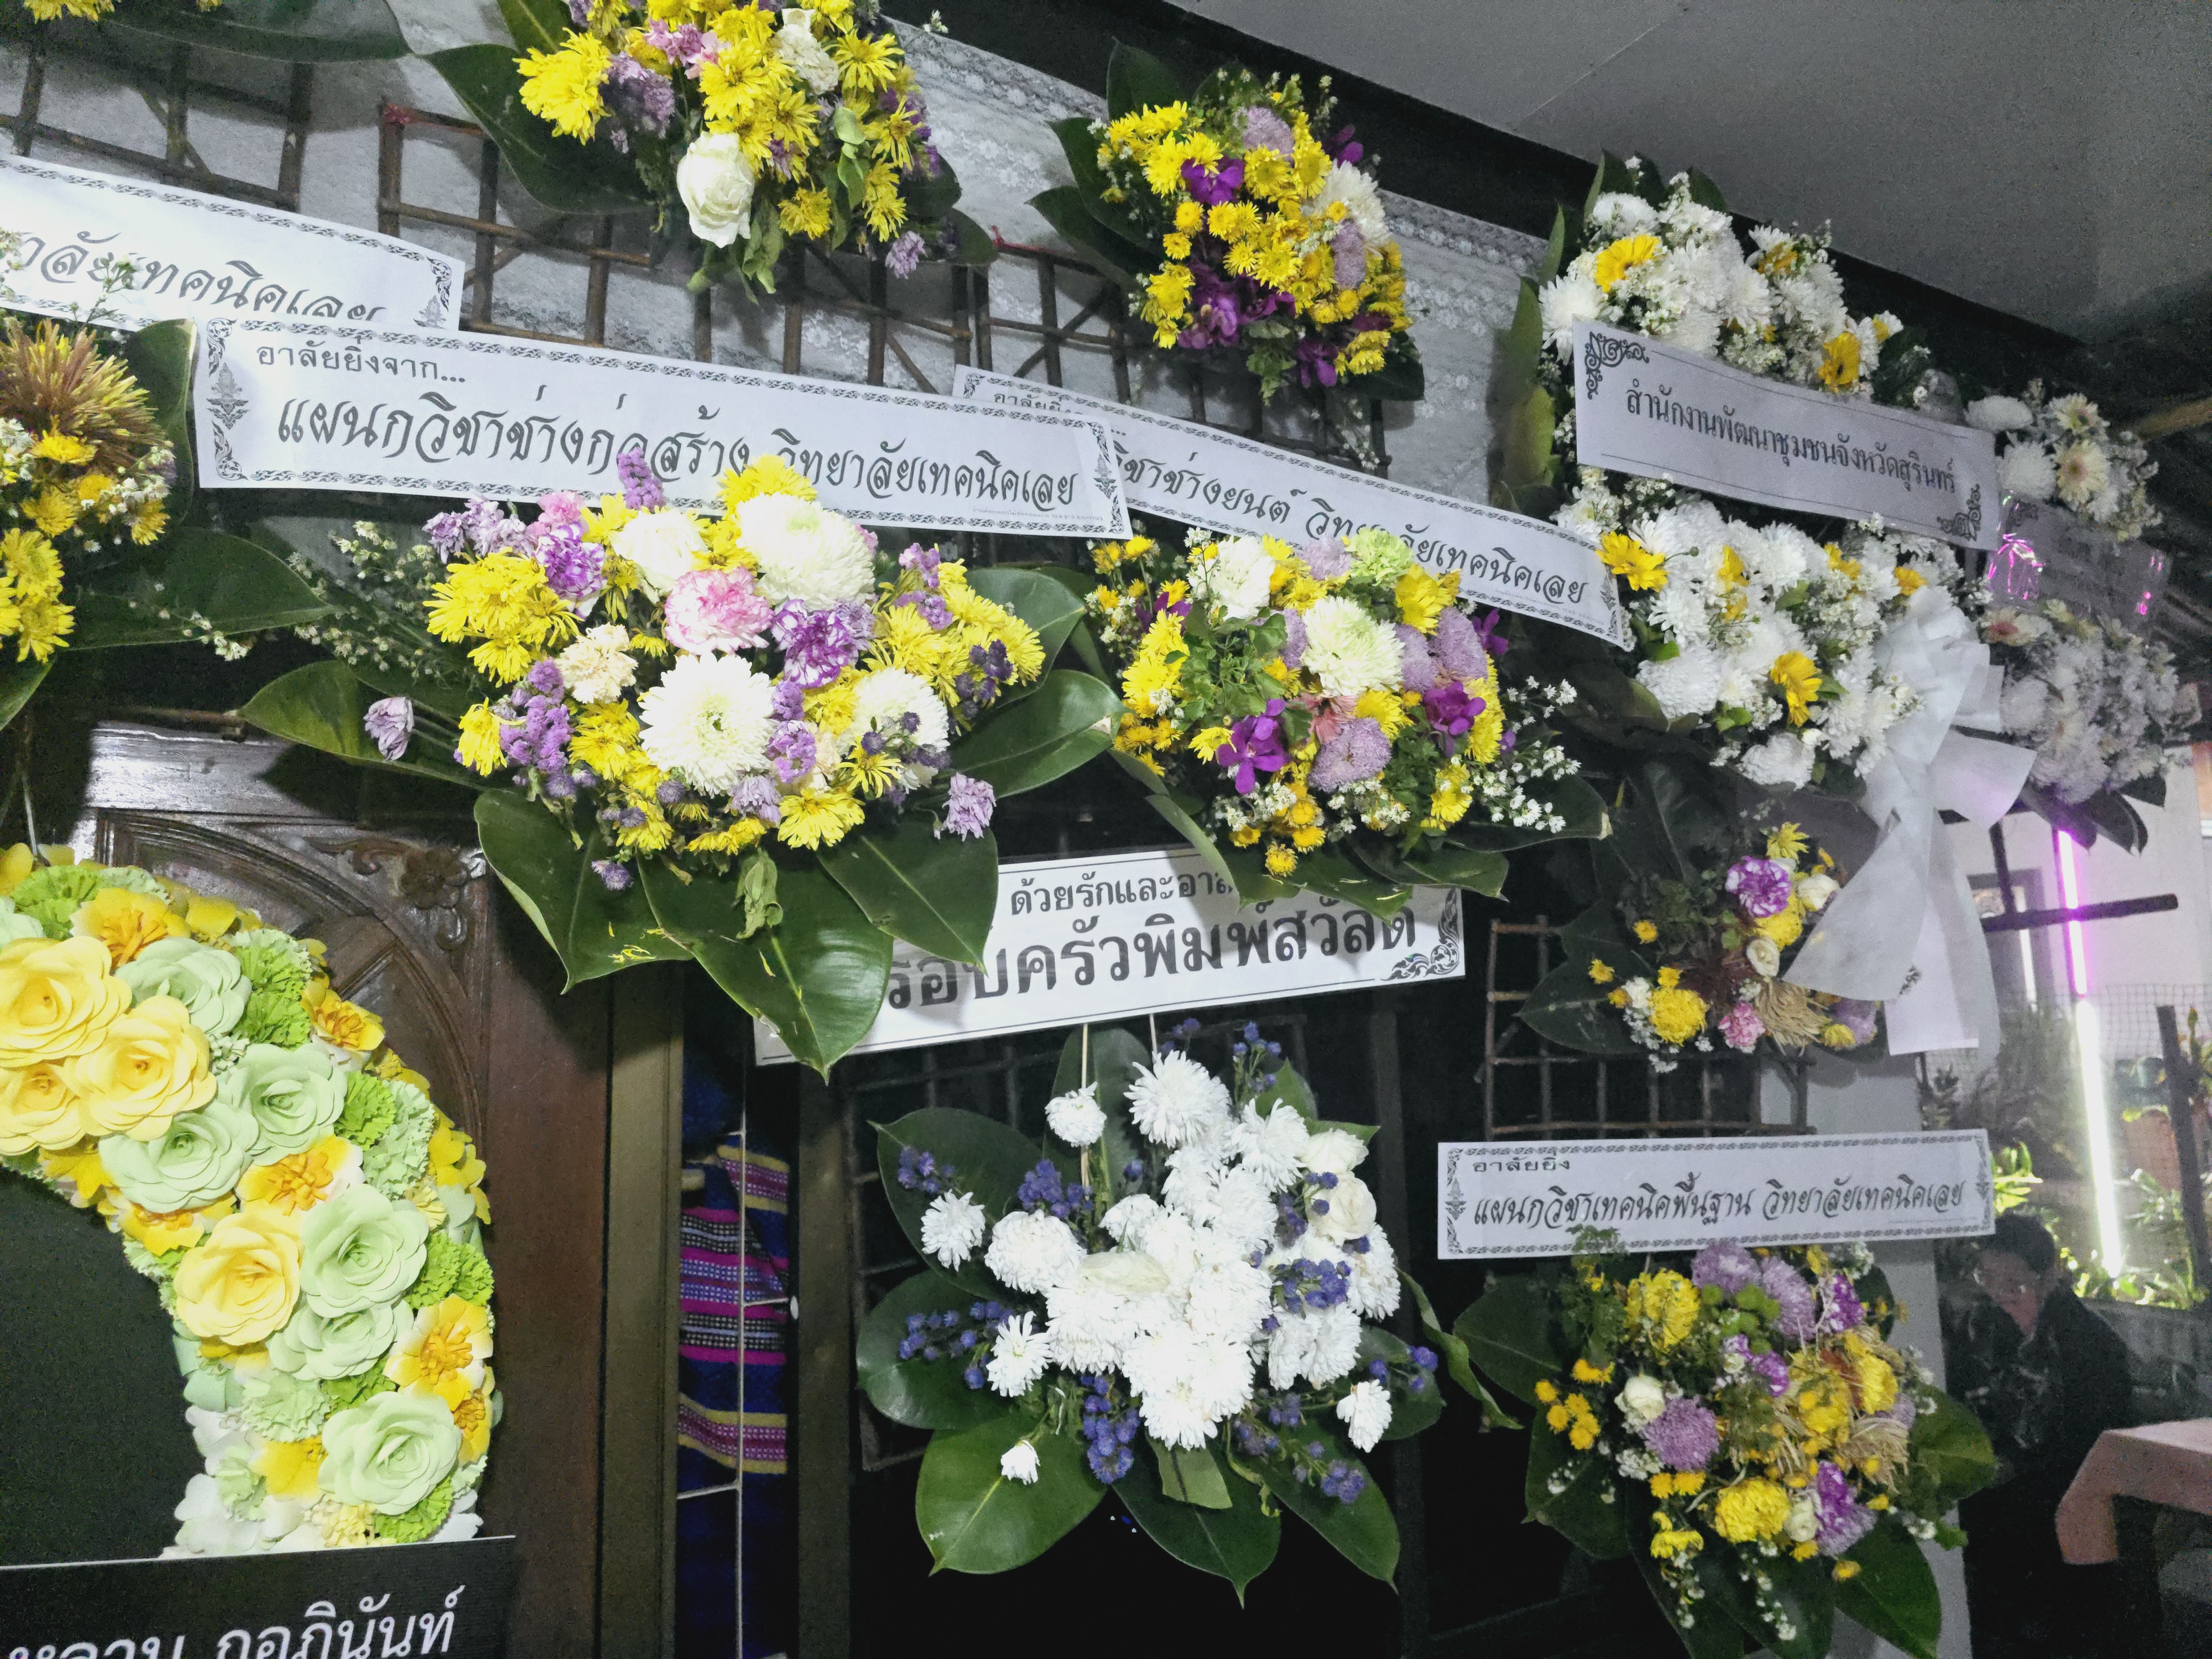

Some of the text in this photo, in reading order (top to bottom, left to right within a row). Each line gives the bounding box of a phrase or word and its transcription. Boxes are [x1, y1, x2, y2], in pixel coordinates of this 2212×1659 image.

[1626, 379, 1956, 493] สำนักงานพัฒนาชุมชนจังหวัดสุรินทร์
[1113, 441, 1588, 603] ิชาช่างยนต์ วิทัยเทคนิคเลย
[1473, 1150, 1570, 1172] อาลัยยิ่ง
[1474, 1171, 1966, 1229] แผนกวิชาเทคนิคพื้นฐาน วิทยาลัยเทคนิคเลย
